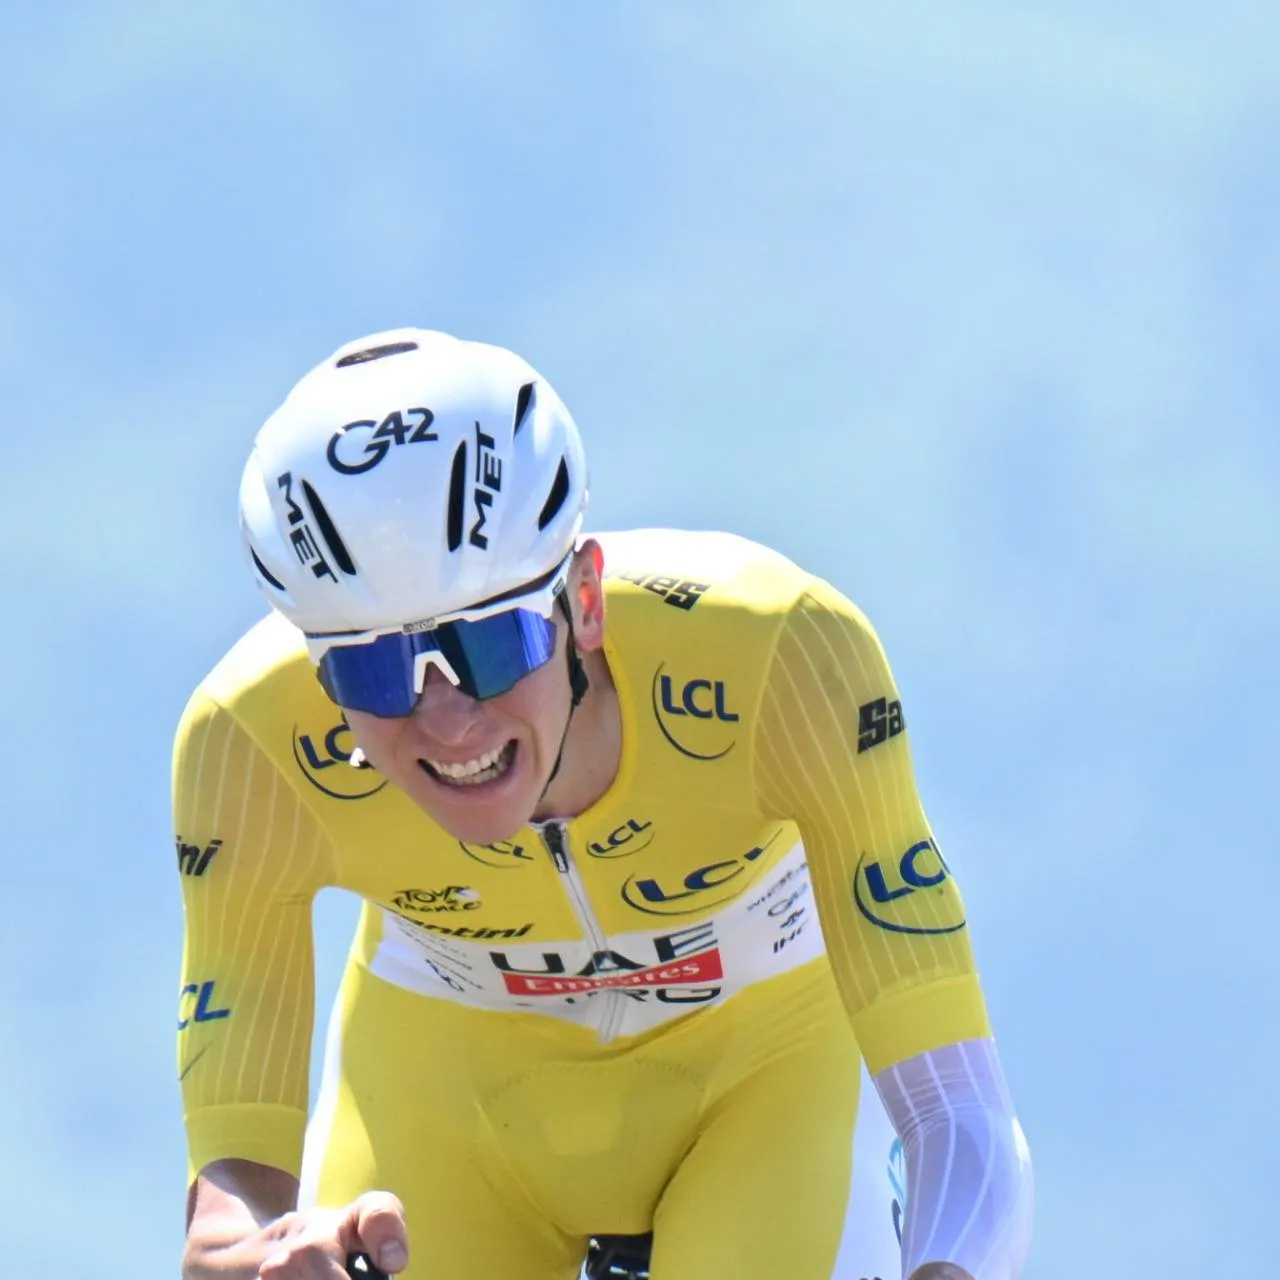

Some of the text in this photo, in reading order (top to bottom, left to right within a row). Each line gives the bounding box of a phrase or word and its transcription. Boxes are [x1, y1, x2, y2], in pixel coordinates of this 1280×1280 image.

[326, 407, 439, 475] G42
[469, 421, 503, 551] MET
[277, 470, 338, 583] MET
[660, 674, 740, 722] LCL
[857, 696, 905, 754] Sa
[299, 725, 354, 769] LC
[590, 818, 652, 855] LCL
[864, 836, 952, 904] LC
[489, 921, 719, 977] UAE
